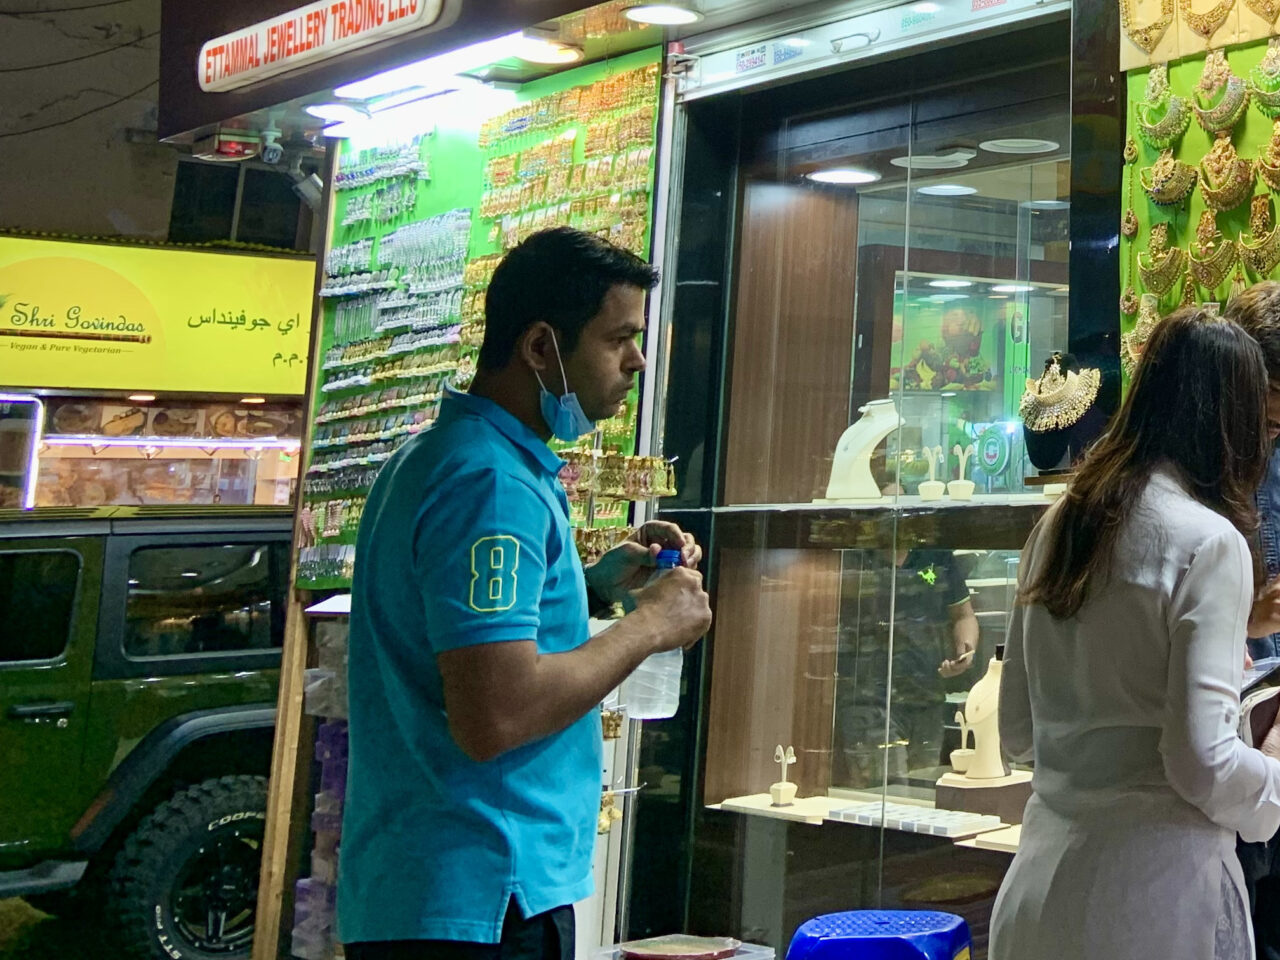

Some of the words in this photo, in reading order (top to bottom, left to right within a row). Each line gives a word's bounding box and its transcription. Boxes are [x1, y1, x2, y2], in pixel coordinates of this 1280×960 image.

[205, 39, 261, 84] ETTAMMAL
[263, 6, 328, 63] JEWELLERY
[10, 302, 56, 328] Shri
[64, 305, 146, 333] Govindas
[10, 342, 38, 352] Vegan
[40, 342, 47, 351] &
[49, 343, 72, 352] Pure
[73, 343, 122, 354] Vegetarian
[468, 534, 520, 612] 8
[207, 811, 266, 832] COOPE
